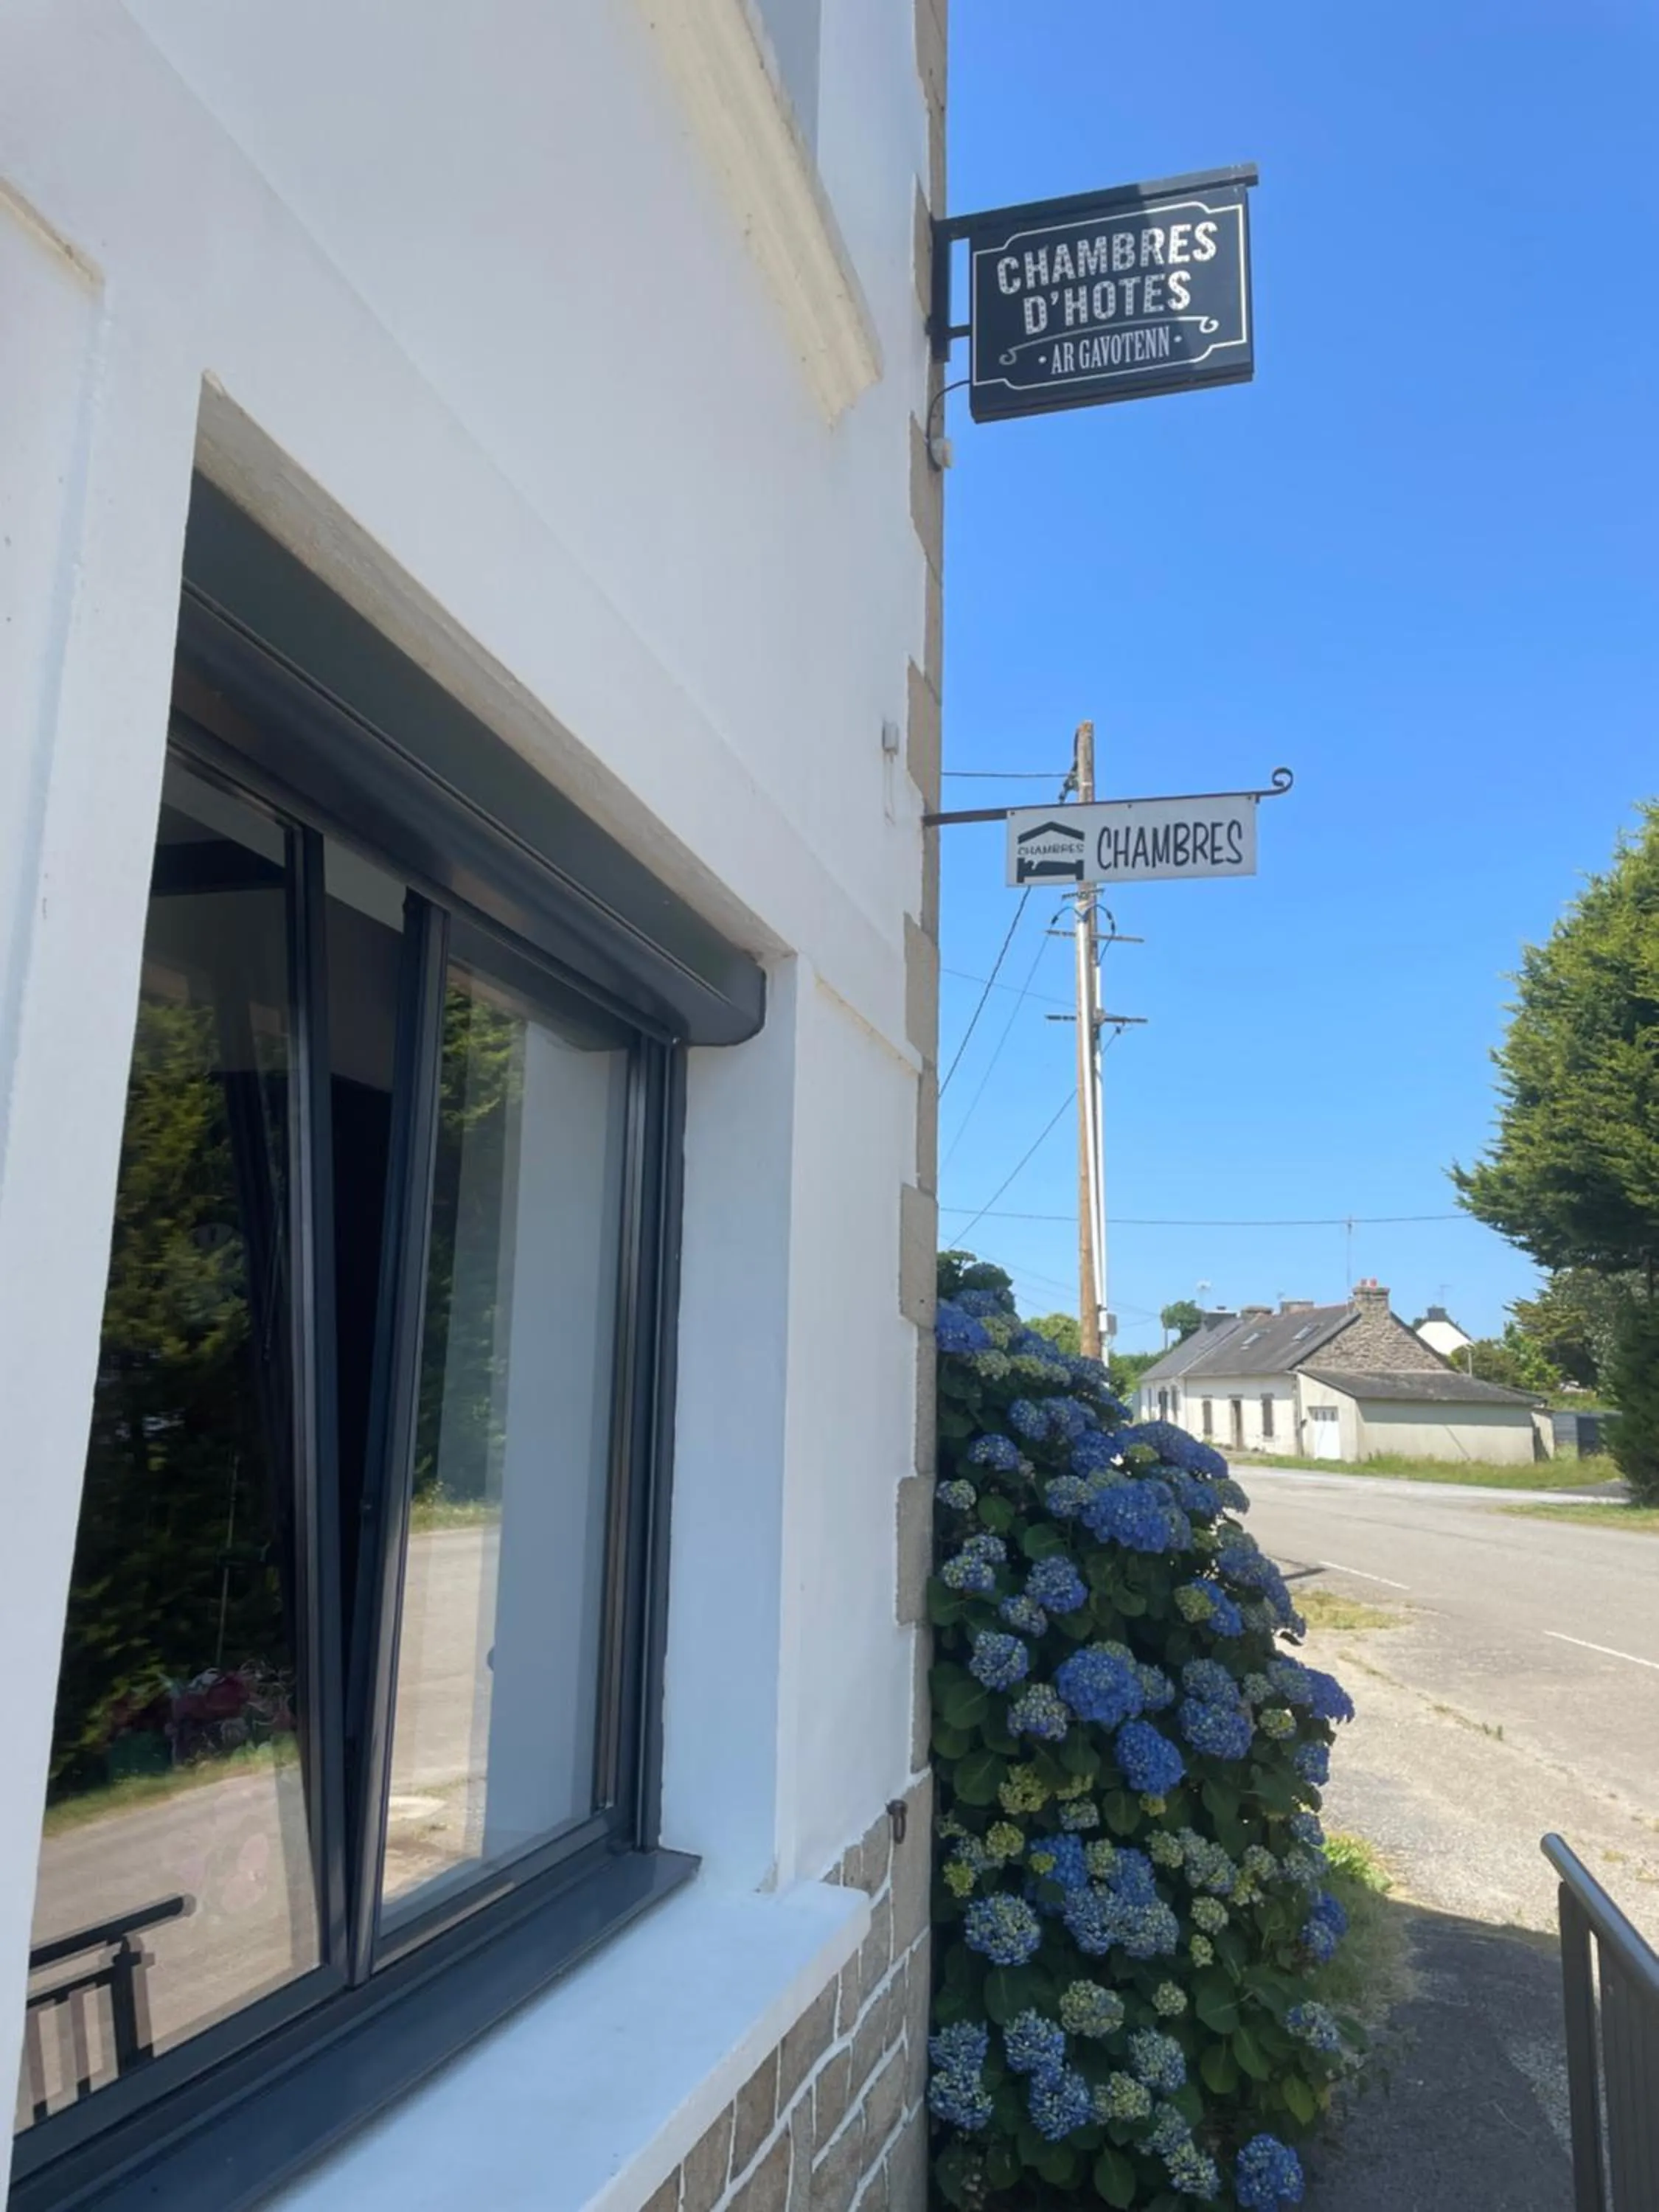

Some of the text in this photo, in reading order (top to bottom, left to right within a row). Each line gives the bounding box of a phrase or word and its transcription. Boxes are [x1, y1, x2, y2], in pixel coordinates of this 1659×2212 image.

[997, 221, 1218, 295] CHAMBRES
[1023, 271, 1192, 335] D'HOTES
[1051, 326, 1170, 375] AR GAVOTENN
[1017, 843, 1085, 855] CHAMBRES
[1096, 819, 1243, 871] CHAMBRES
